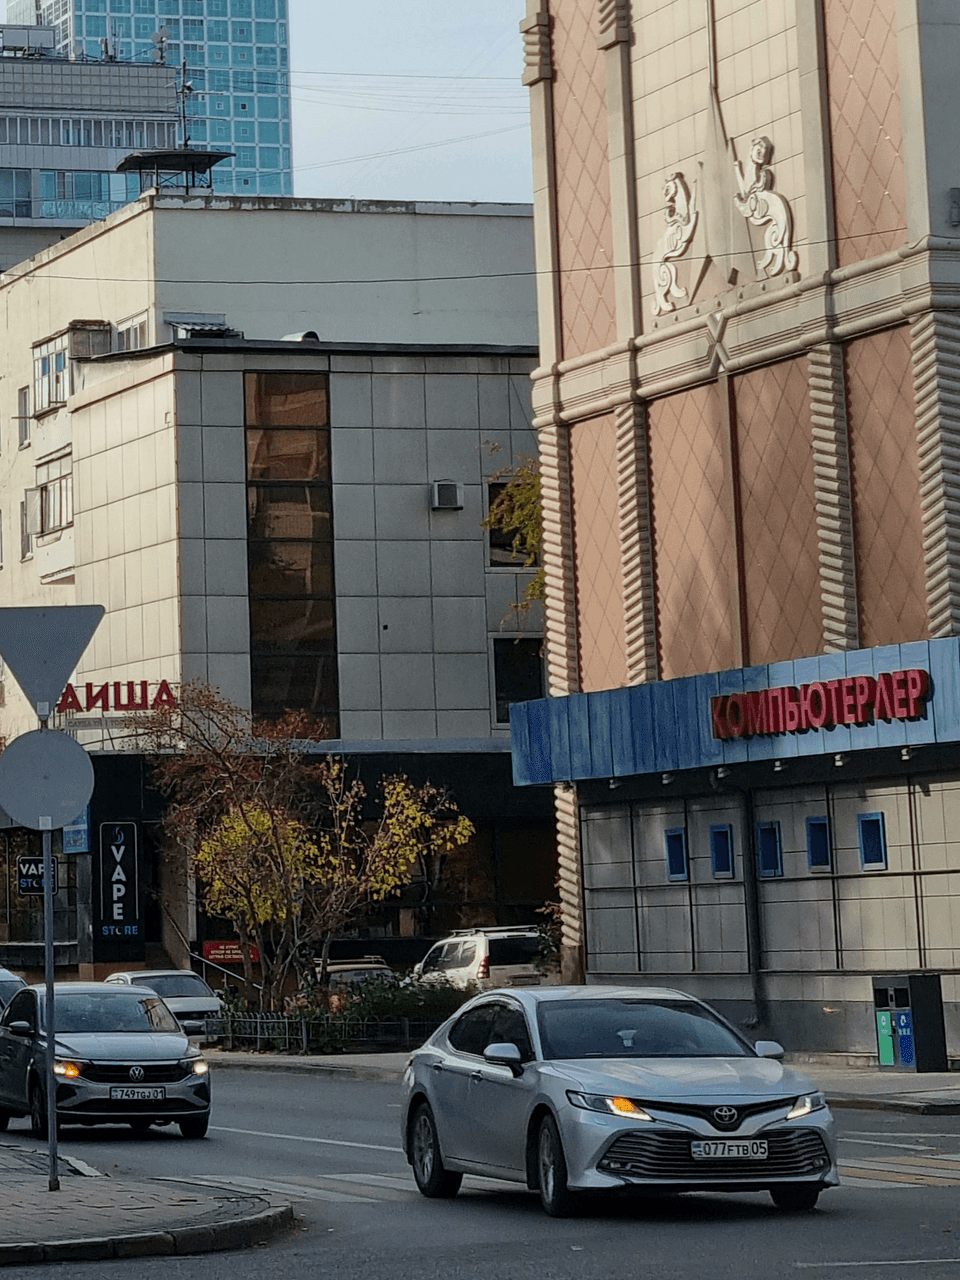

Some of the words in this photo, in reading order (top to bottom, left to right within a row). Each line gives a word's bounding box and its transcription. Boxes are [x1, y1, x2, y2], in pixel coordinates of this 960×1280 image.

[57, 680, 178, 713] АИША
[712, 669, 928, 739] КОМПЬЮТЕРЛЕР
[110, 845, 127, 920] VAPE
[703, 1142, 749, 1155] 077FTB
[751, 1142, 767, 1154] 05
